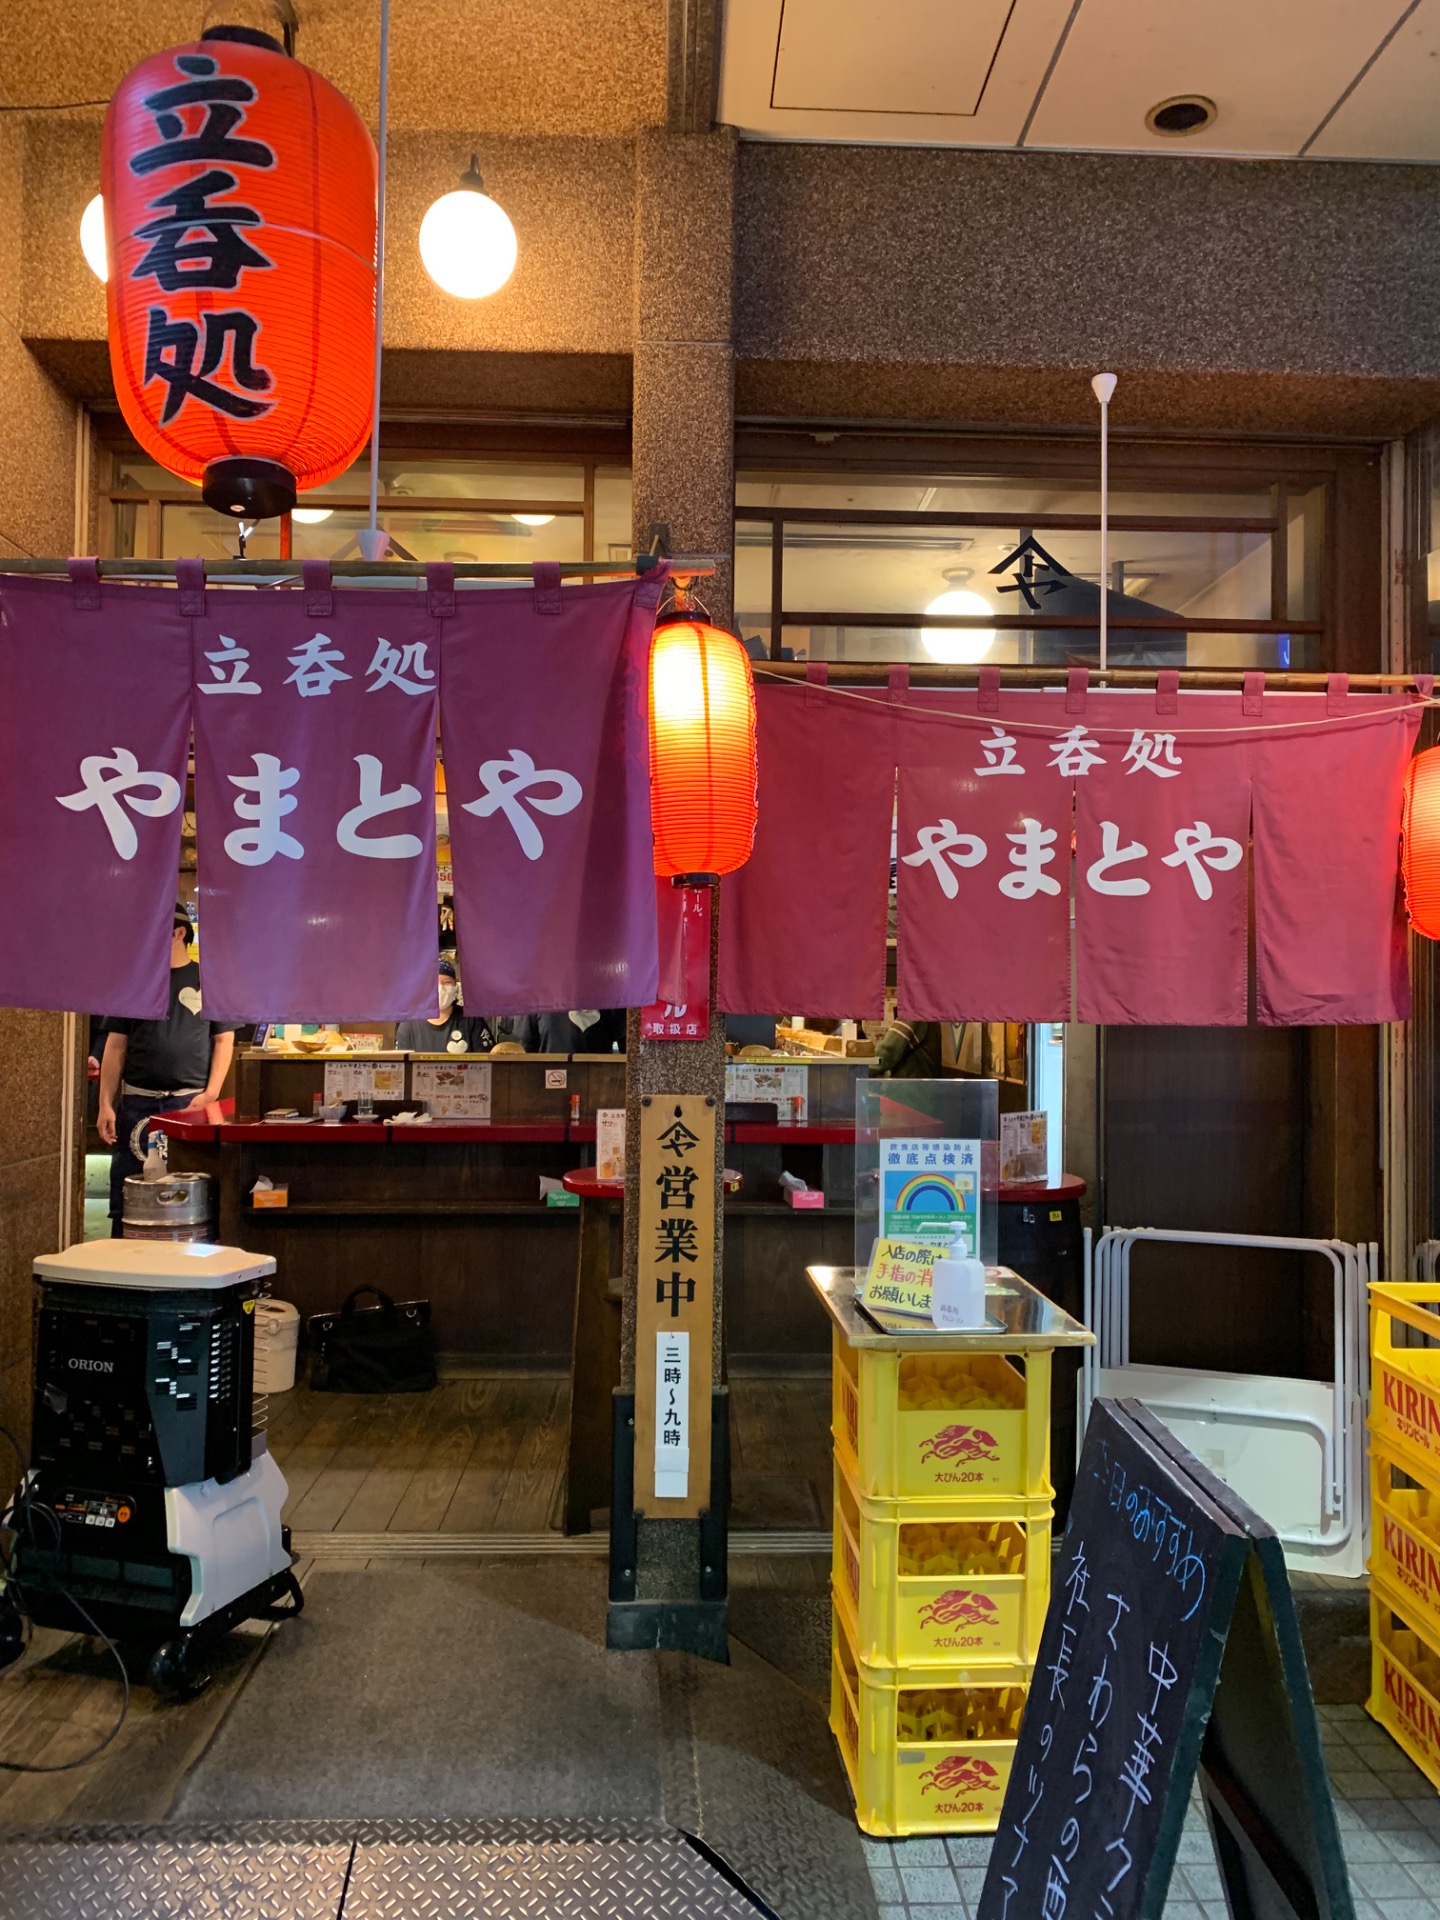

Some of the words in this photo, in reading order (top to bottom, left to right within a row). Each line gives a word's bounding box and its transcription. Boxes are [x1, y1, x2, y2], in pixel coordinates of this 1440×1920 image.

[130, 55, 277, 428] 立呑処
[197, 633, 437, 697] 立呑処
[973, 725, 1183, 778] 立呑処
[55, 747, 583, 866] やまとや
[901, 818, 1244, 900] やまとや
[653, 1023, 697, 1034] 取扱店
[888, 1153, 973, 1165] 徹底点検済
[890, 1143, 972, 1151] 飲食店等感染防止
[655, 1165, 700, 1317] 営業中
[68, 1358, 114, 1373] ORION
[1383, 1370, 1440, 1438] KIRIN
[934, 1472, 984, 1483] 大びん20本
[1384, 1515, 1440, 1597] KIRIN
[934, 1636, 983, 1648] 大びん20本
[1384, 1657, 1440, 1752] KIRIN
[935, 1802, 984, 1814] 大びん20本
